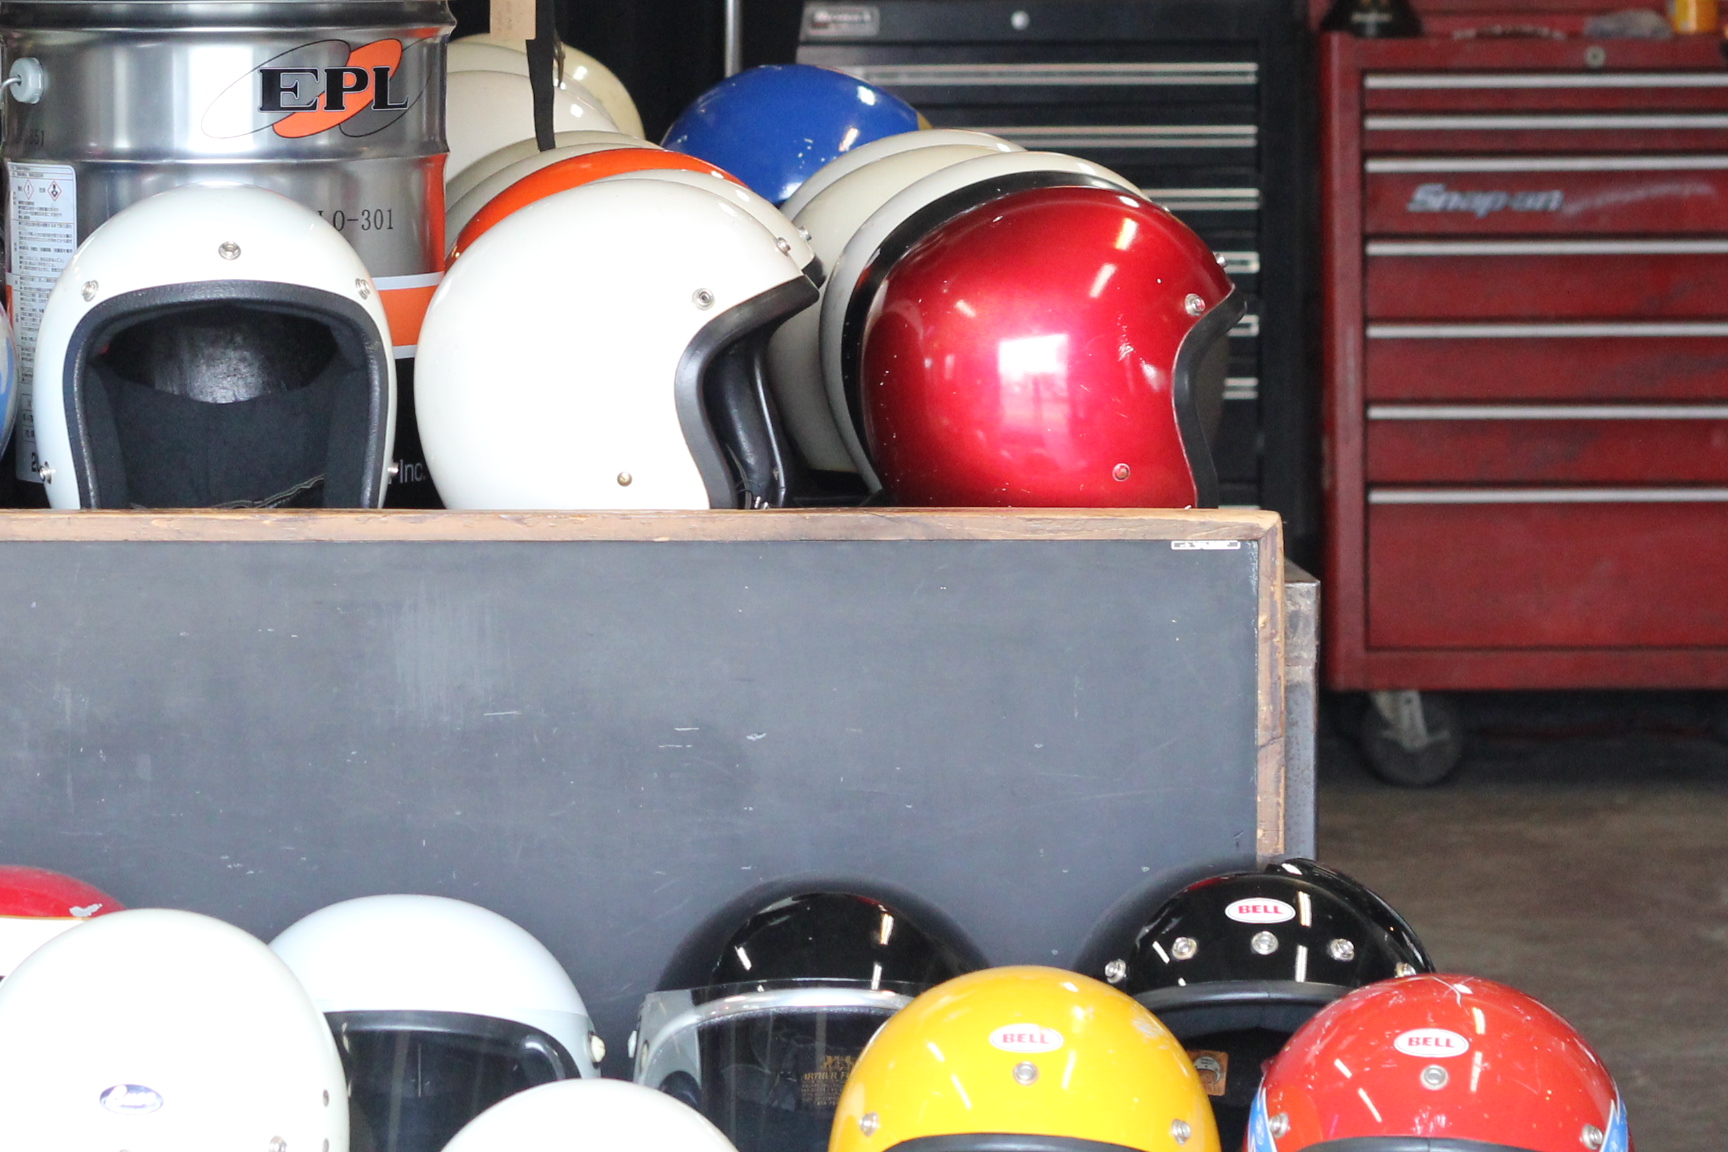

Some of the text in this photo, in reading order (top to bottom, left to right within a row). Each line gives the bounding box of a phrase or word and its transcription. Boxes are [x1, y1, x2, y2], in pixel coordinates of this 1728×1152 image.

[258, 66, 409, 112] EPL
[317, 209, 394, 232] O-301
[1237, 904, 1284, 915] BELL
[1002, 1033, 1049, 1044] BELL
[1407, 1036, 1455, 1049] BELL
